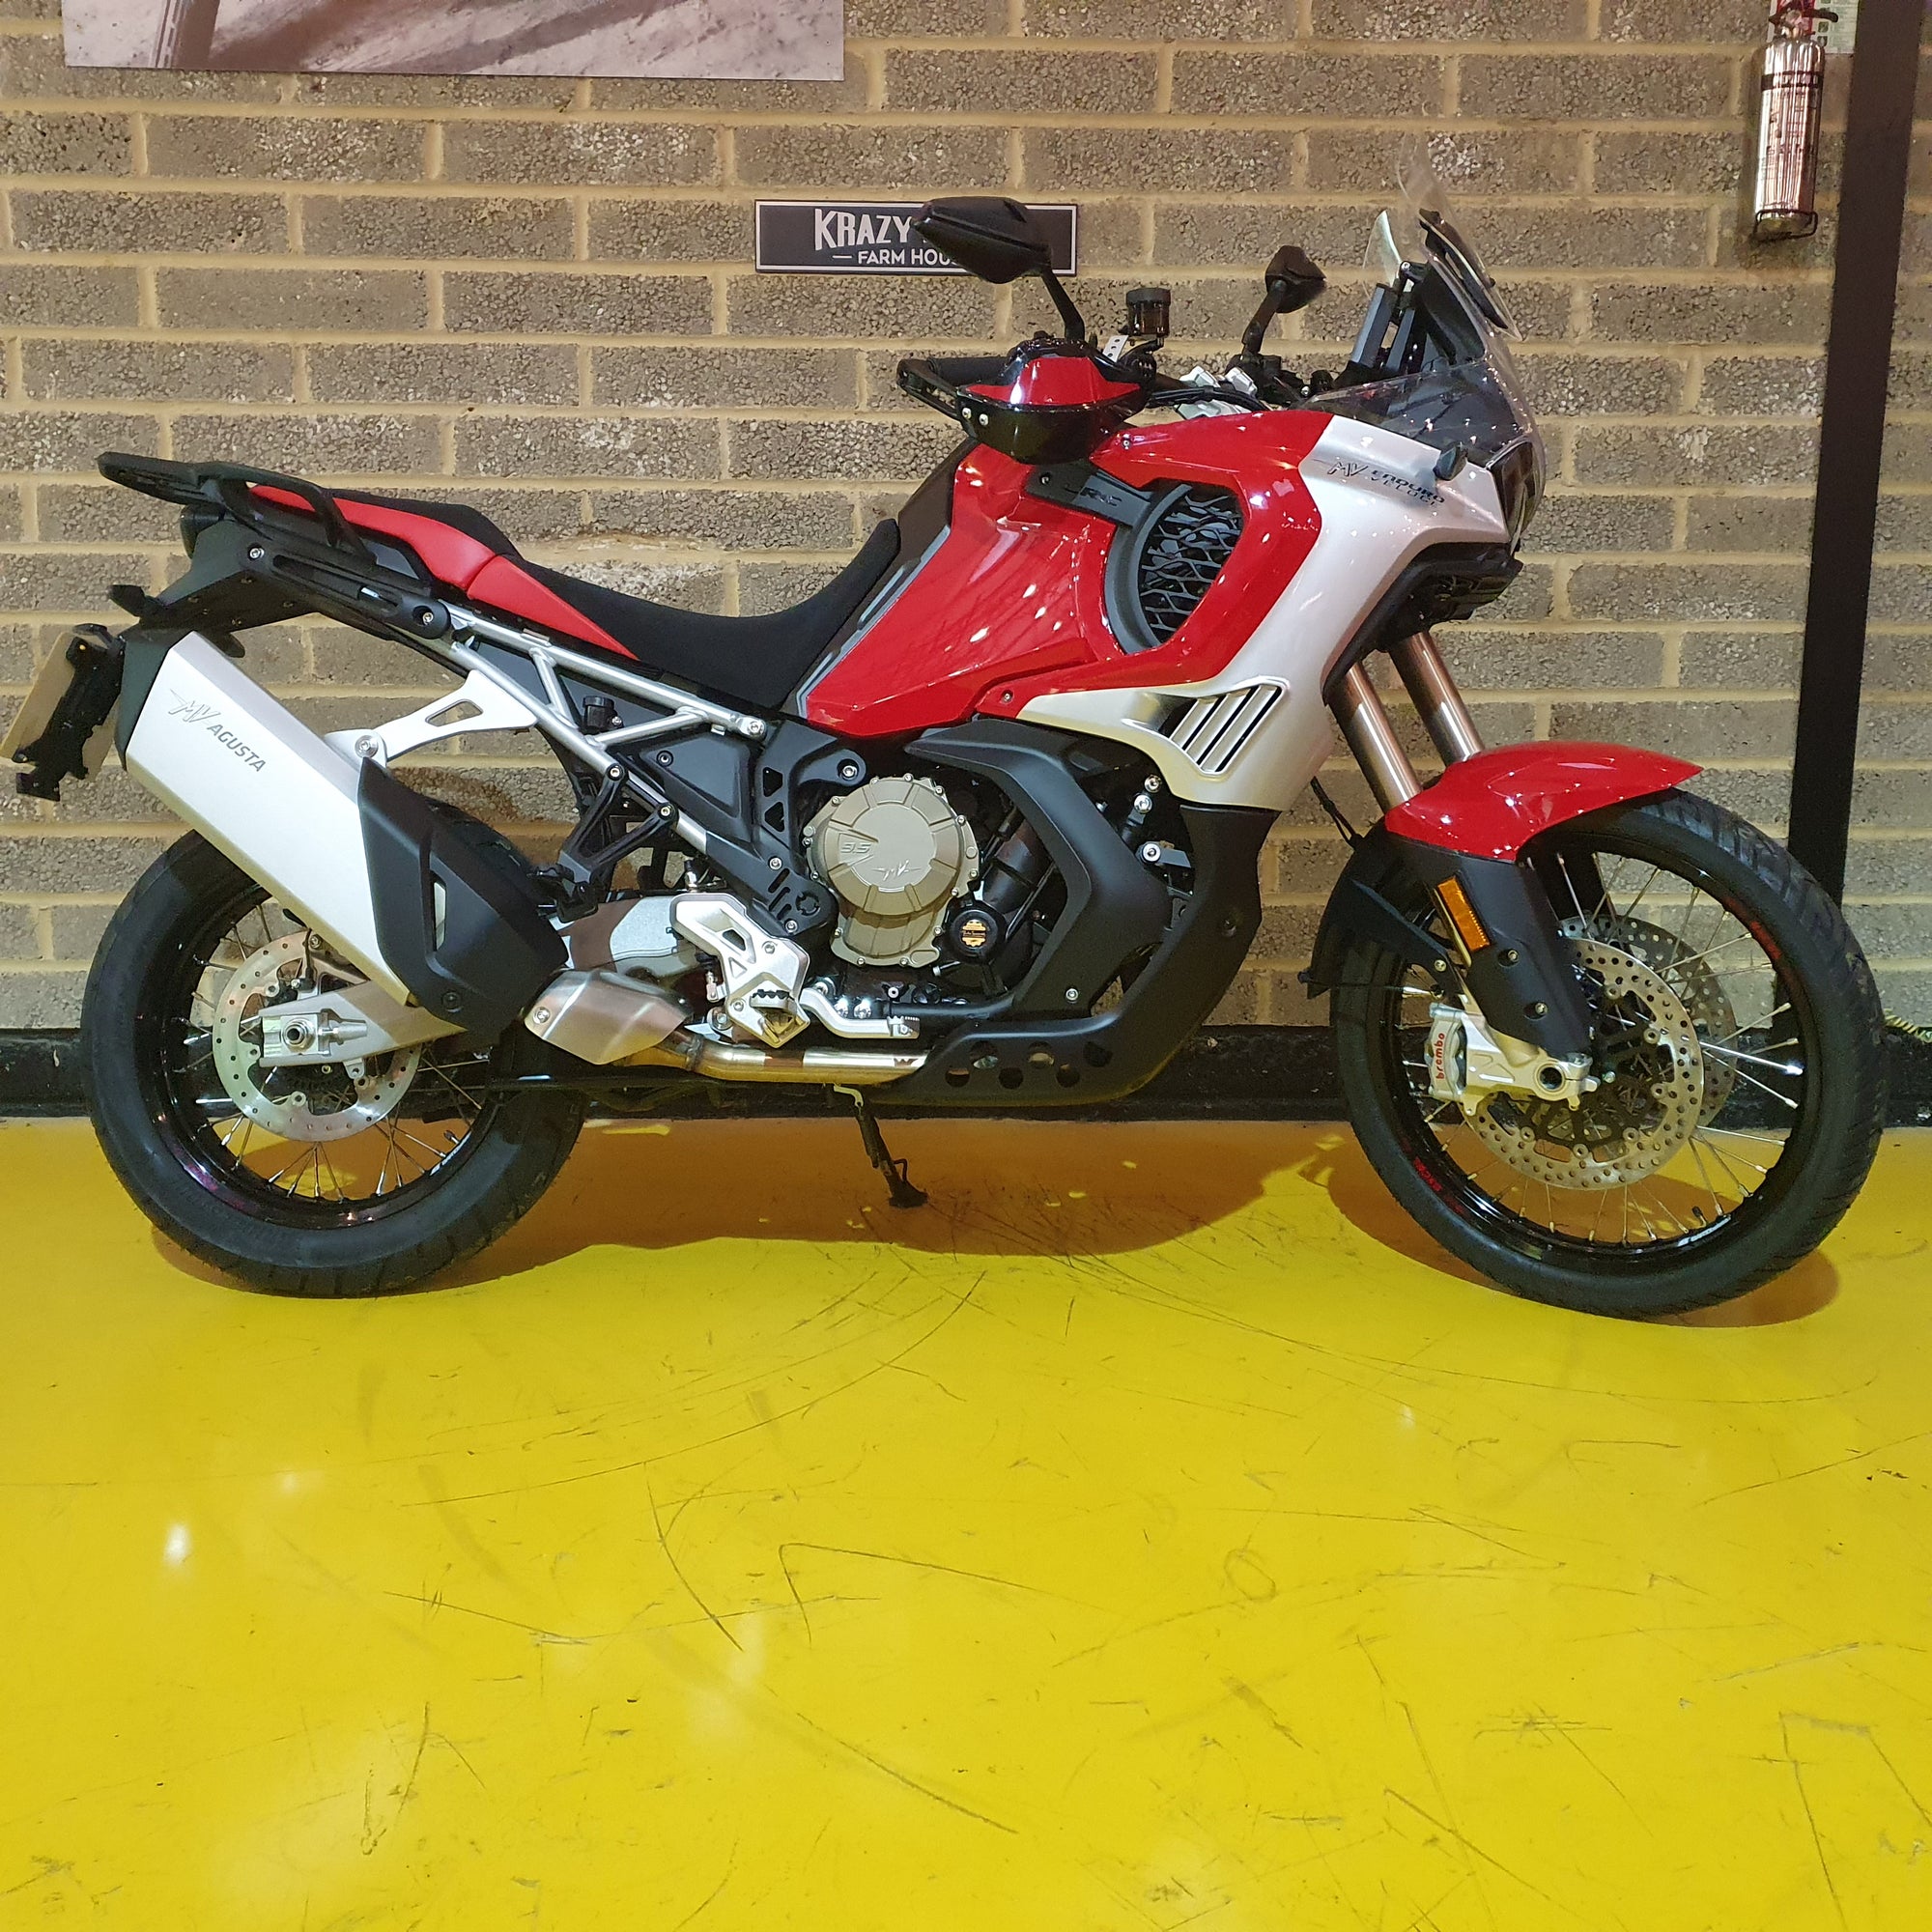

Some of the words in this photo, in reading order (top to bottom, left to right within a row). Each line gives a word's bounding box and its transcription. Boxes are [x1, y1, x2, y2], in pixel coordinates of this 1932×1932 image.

[814, 208, 913, 250] KRAZY
[858, 248, 905, 265] FARM
[911, 248, 958, 266] HOU
[207, 724, 267, 772] AGUSTA
[1435, 1033, 1445, 1080] brembo
